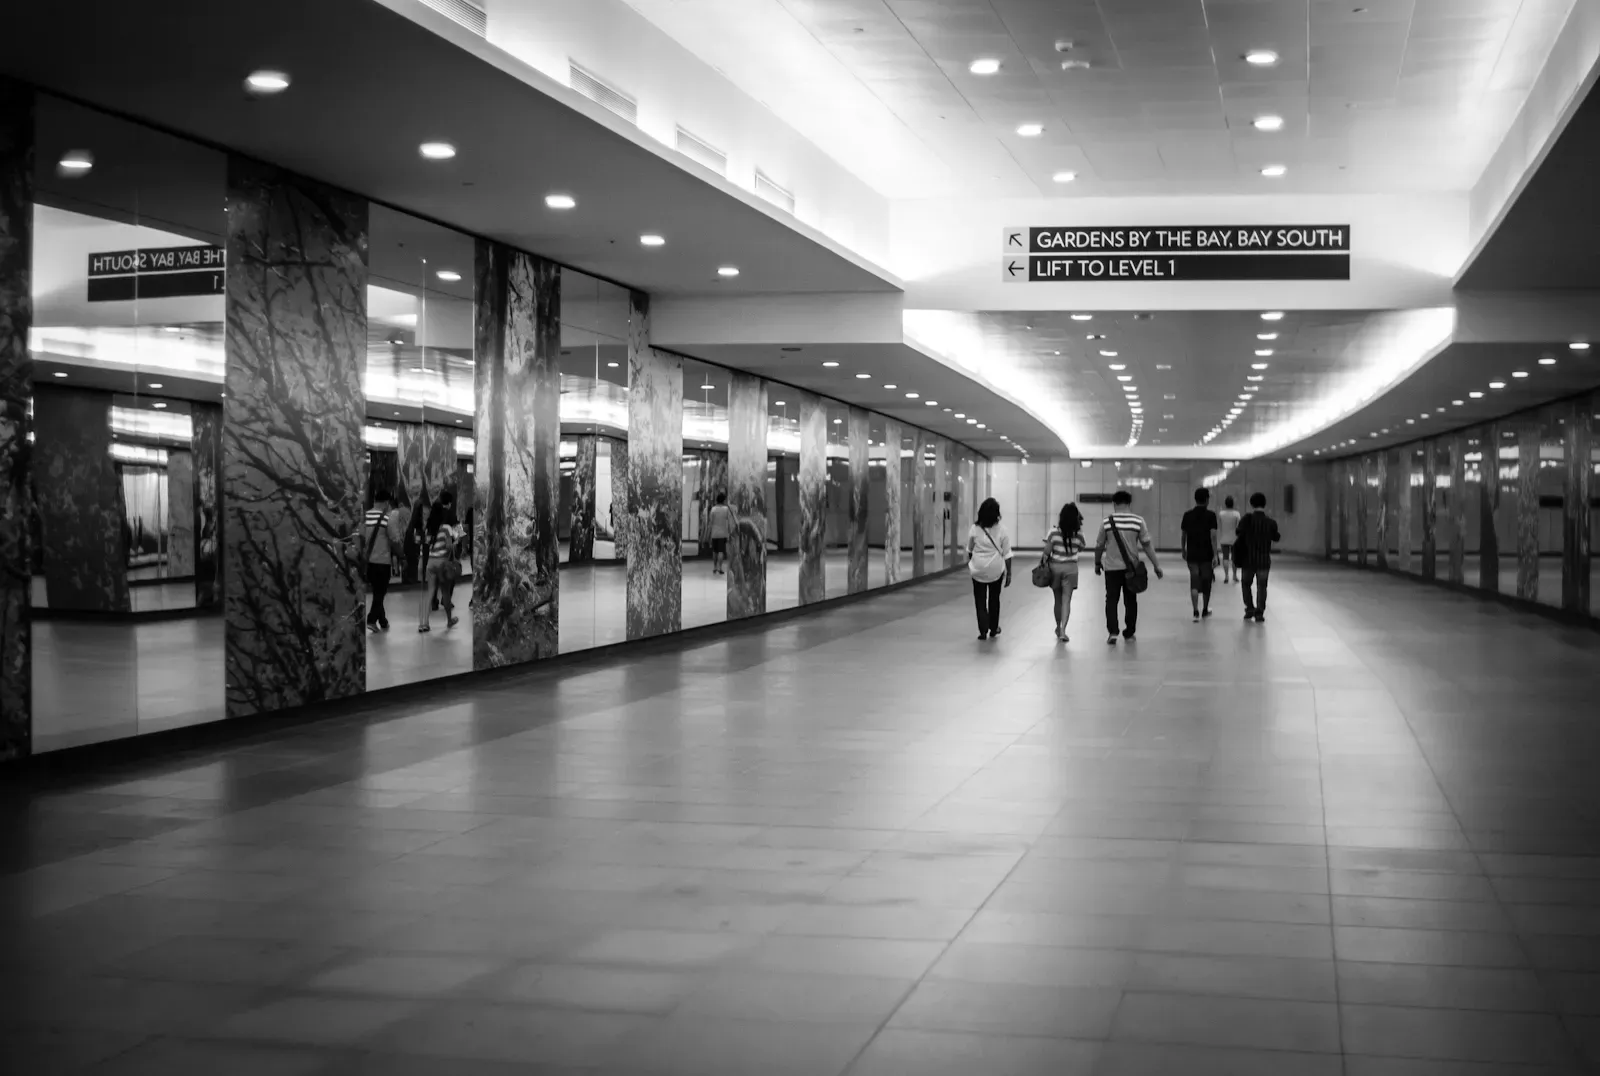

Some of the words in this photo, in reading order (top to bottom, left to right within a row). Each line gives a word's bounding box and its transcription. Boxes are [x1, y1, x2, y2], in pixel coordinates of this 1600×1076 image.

[1037, 231, 1125, 248] GARDENS
[1129, 231, 1152, 247] BY
[1155, 231, 1192, 247] THE
[1196, 231, 1233, 249] BAY,
[1237, 230, 1273, 247] BAY
[1276, 230, 1343, 247] SOUTH
[1036, 260, 1074, 277] LIFT
[1077, 260, 1105, 276] TO
[1109, 260, 1165, 276] LEVEL
[1168, 259, 1175, 276] 1
